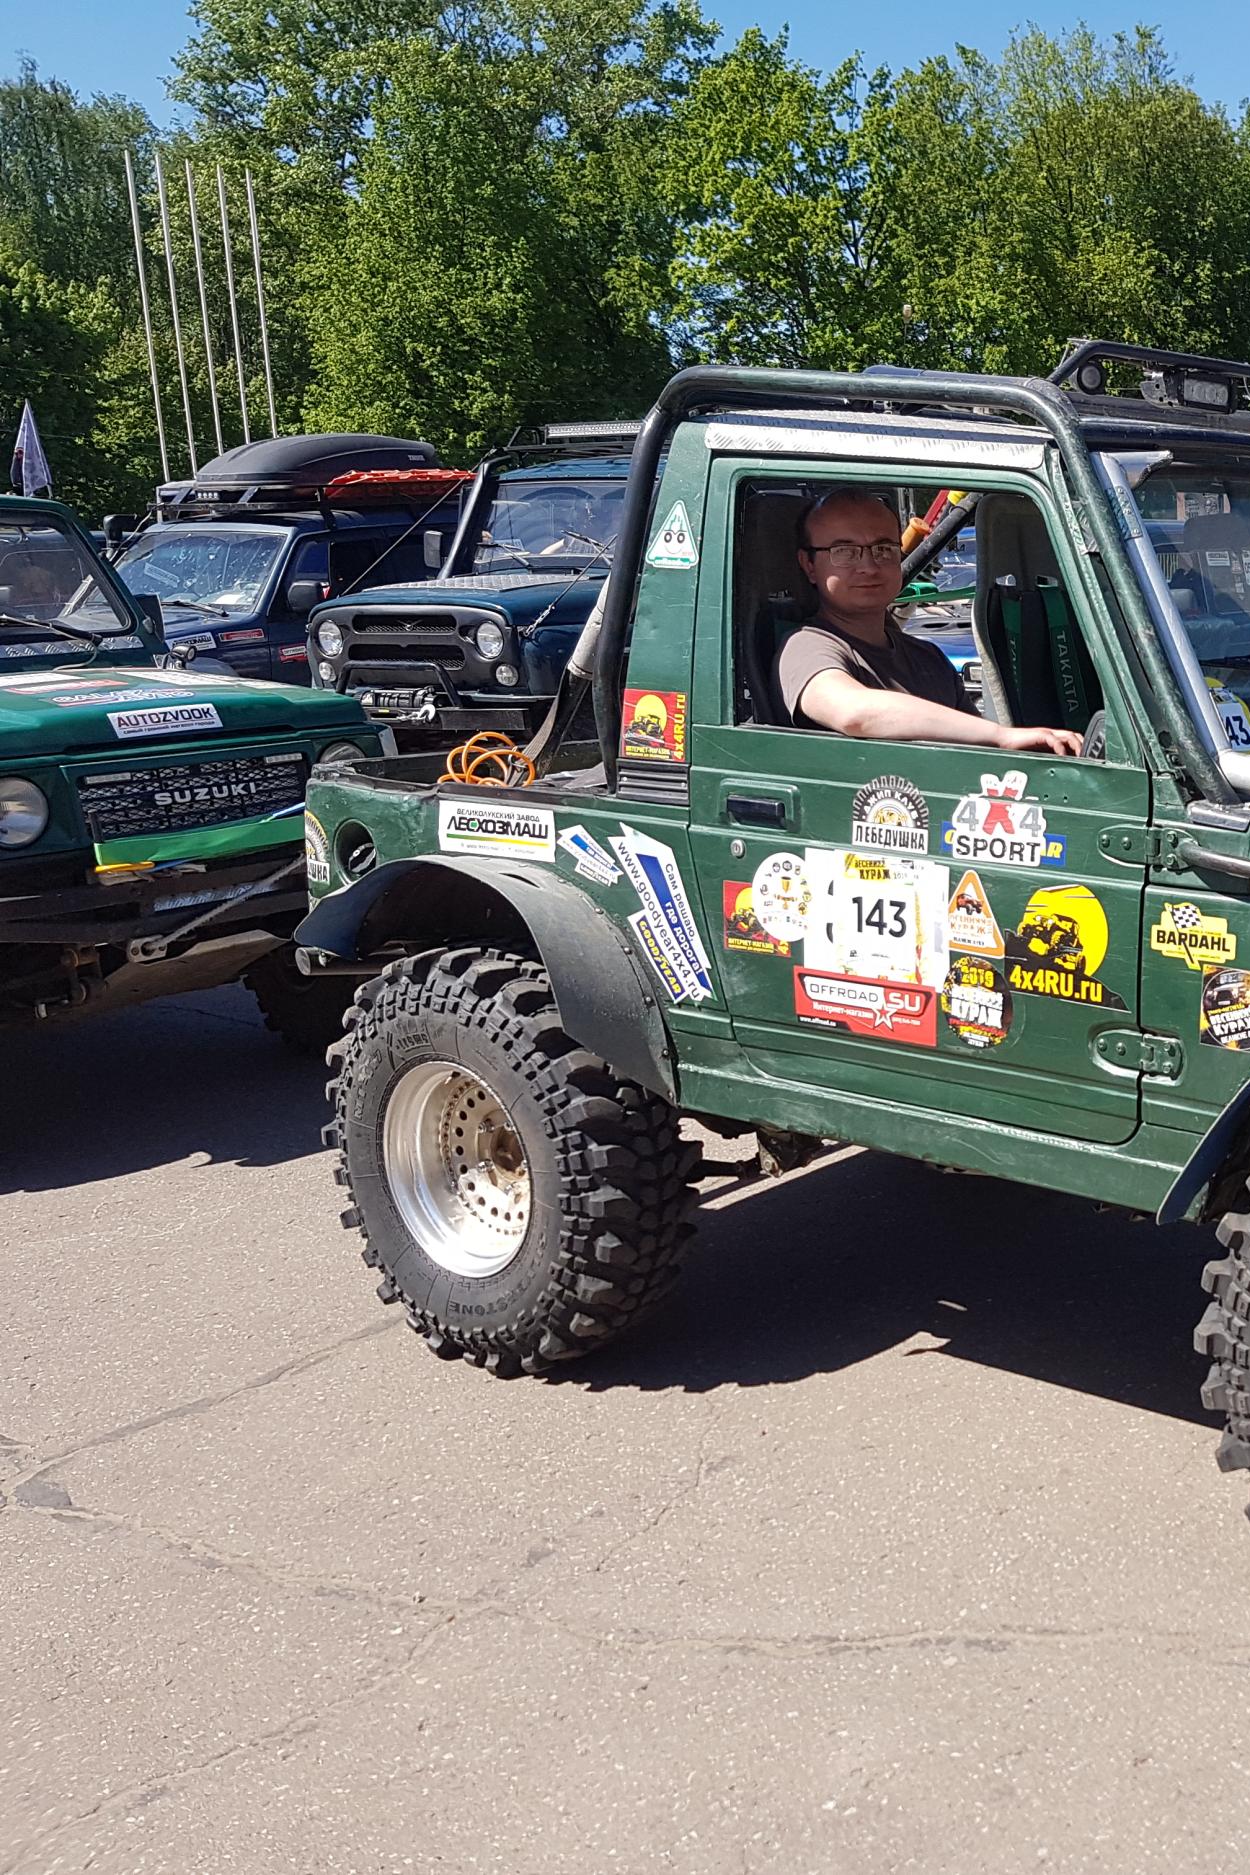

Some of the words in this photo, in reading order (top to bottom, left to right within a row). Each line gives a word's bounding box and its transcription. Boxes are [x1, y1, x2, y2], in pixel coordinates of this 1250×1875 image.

[1057, 630, 1079, 712] TAKATA
[117, 707, 214, 728] AUTOZVOOK
[154, 781, 258, 806] SUZUKI
[447, 816, 548, 839] ЛЕСХОЗМАШ
[456, 808, 515, 820] ВЕЛИКОЛУКСКИЙ
[516, 813, 540, 823] ЗАВОД
[855, 825, 925, 851] ЛЕБЕДУШКА
[956, 835, 1040, 862] SPORT
[665, 863, 678, 891] Сам
[673, 893, 695, 942] решаю,
[618, 842, 701, 999] www.goodyear4x4.ru
[851, 896, 907, 938] 143
[673, 927, 704, 975] дорога!
[1156, 930, 1231, 952] BARDAHL
[638, 920, 683, 995] GOODYEAR
[961, 965, 994, 988] 2019
[1009, 964, 1102, 1003] 4x4RU.ru
[809, 983, 879, 1003] OFFROAD
[887, 992, 921, 1012] SU
